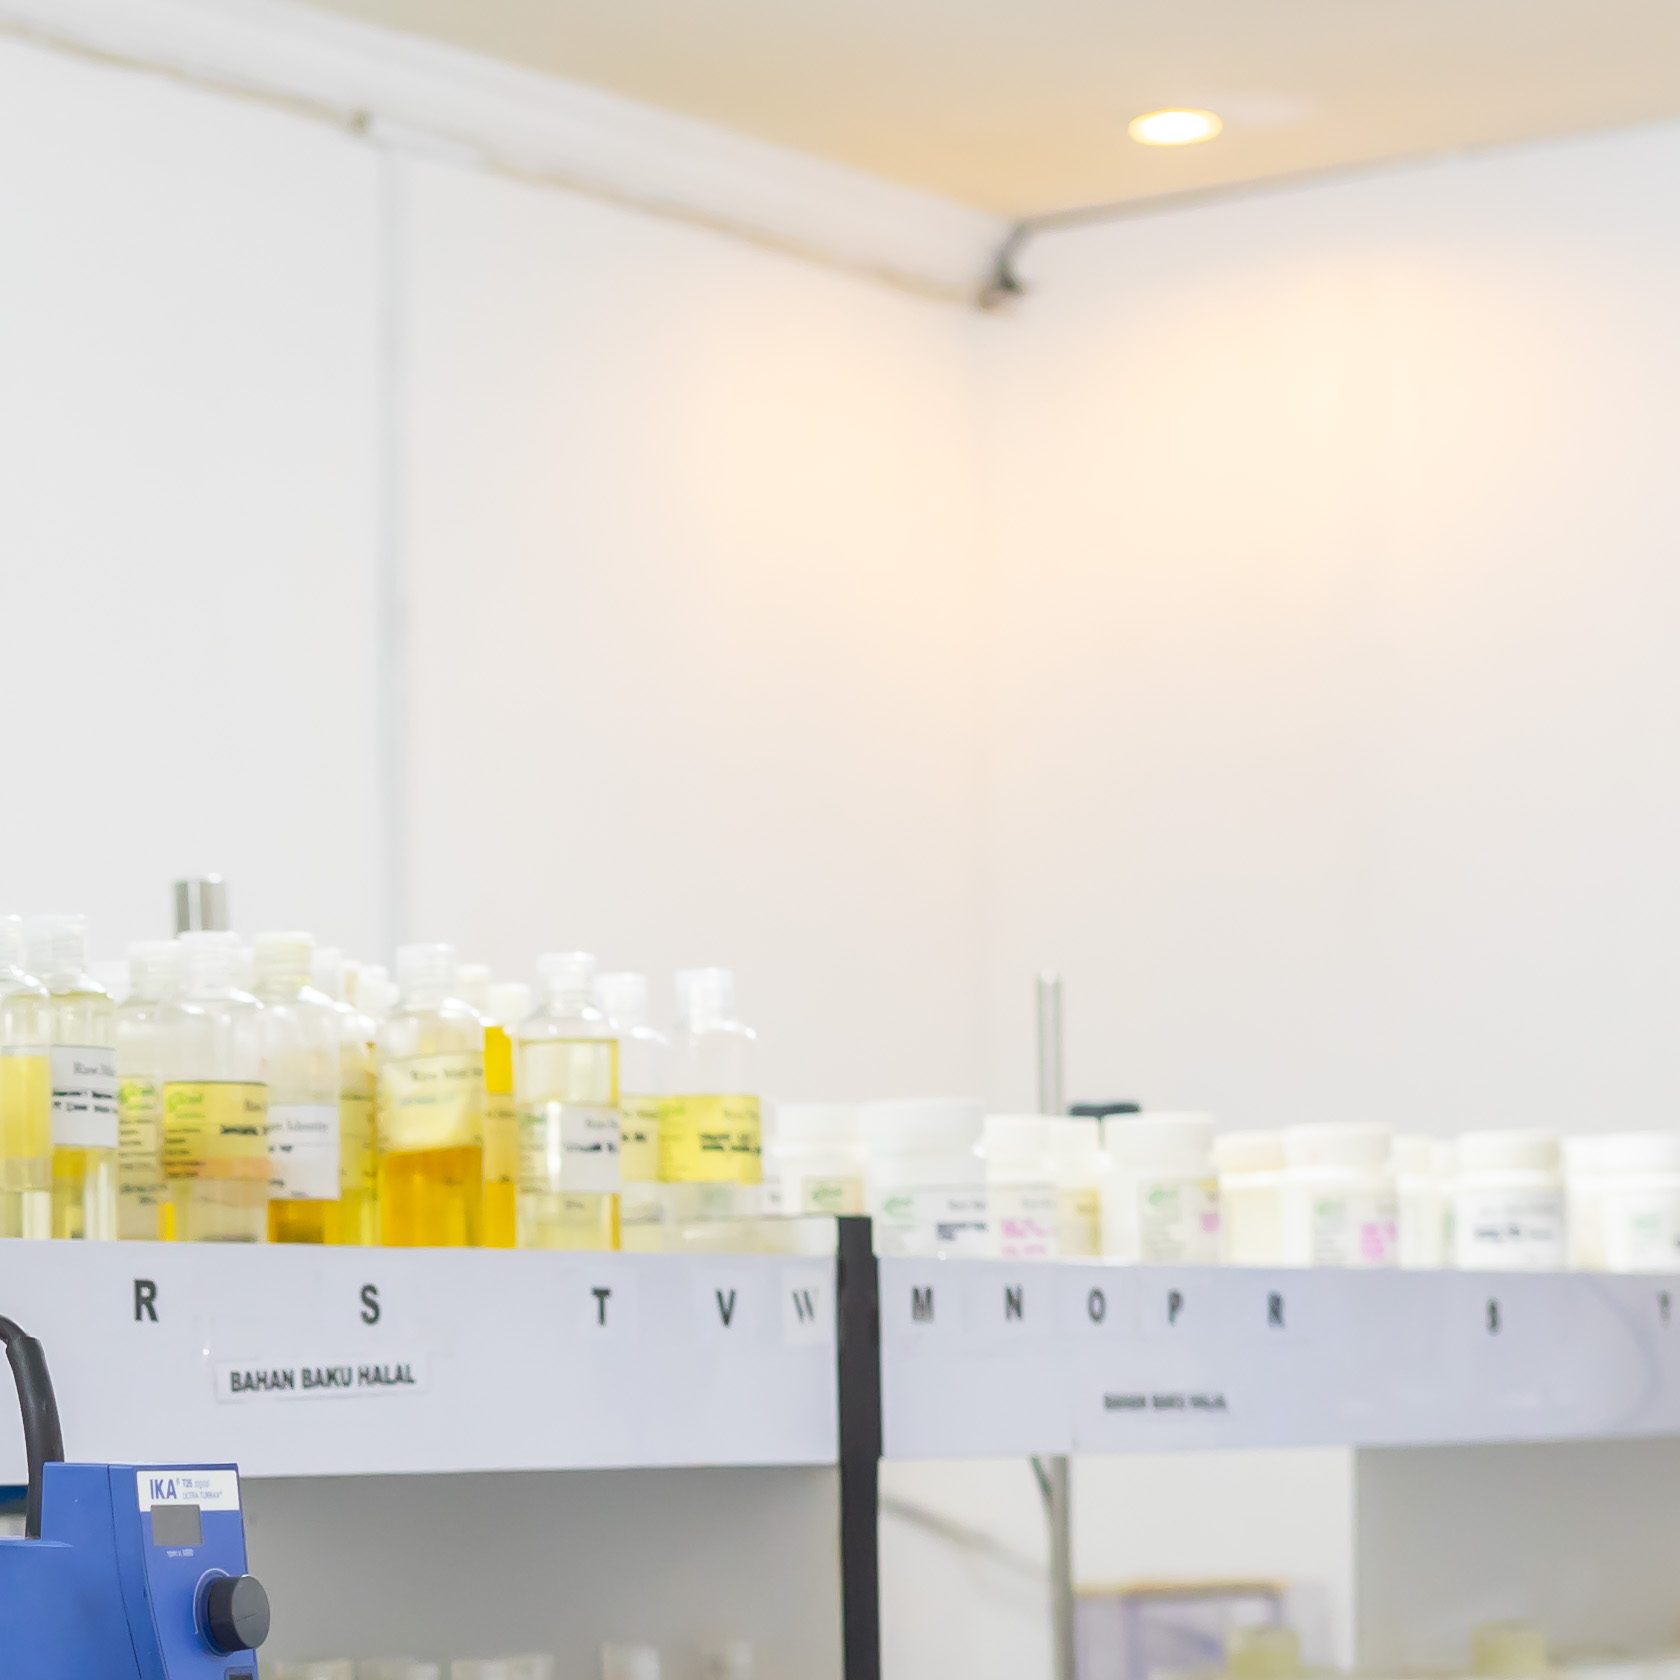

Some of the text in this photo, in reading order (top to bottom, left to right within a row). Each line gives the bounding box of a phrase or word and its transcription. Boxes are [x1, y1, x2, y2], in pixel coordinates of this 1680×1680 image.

[132, 1277, 160, 1324] R
[358, 1282, 382, 1327] S
[590, 1286, 613, 1327] T
[715, 1288, 737, 1328] V
[791, 1288, 816, 1323] W
[910, 1285, 935, 1322] M
[1004, 1285, 1024, 1321] N
[1086, 1286, 1108, 1325] O
[1166, 1288, 1185, 1324] P
[230, 1363, 416, 1393] BAHAN BAKU HALAL
[149, 1478, 177, 1500] IKA
